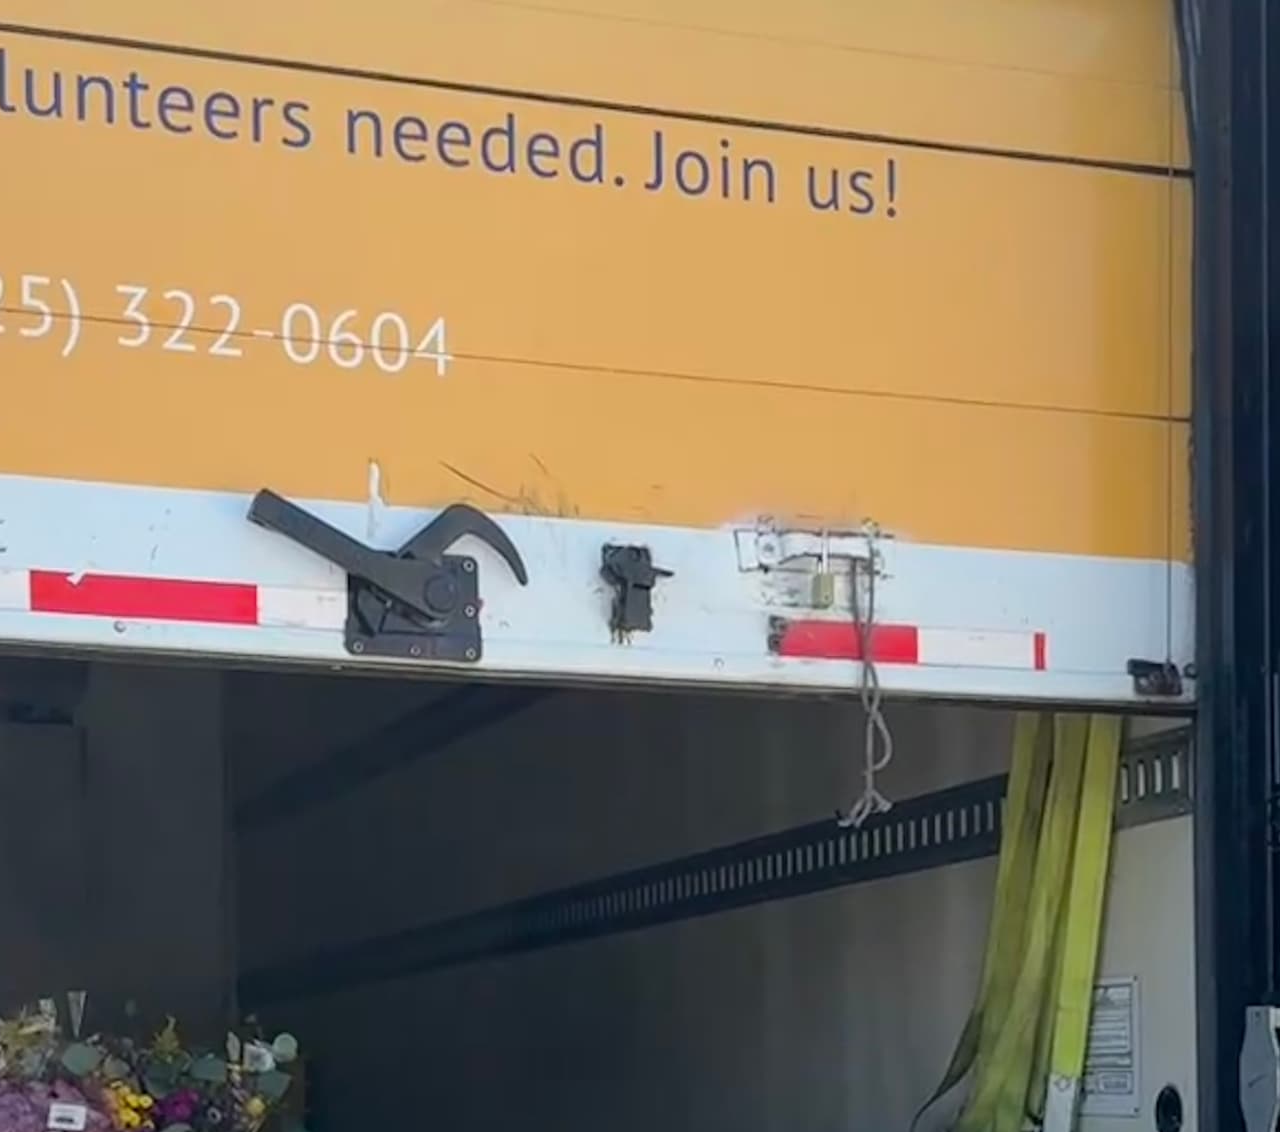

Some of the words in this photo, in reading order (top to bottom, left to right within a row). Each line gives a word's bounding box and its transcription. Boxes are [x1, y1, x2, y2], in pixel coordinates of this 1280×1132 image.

[344, 113, 626, 187] needed.
[644, 130, 777, 204] Join
[806, 159, 901, 219] us!
[116, 283, 455, 377] 322-0604
